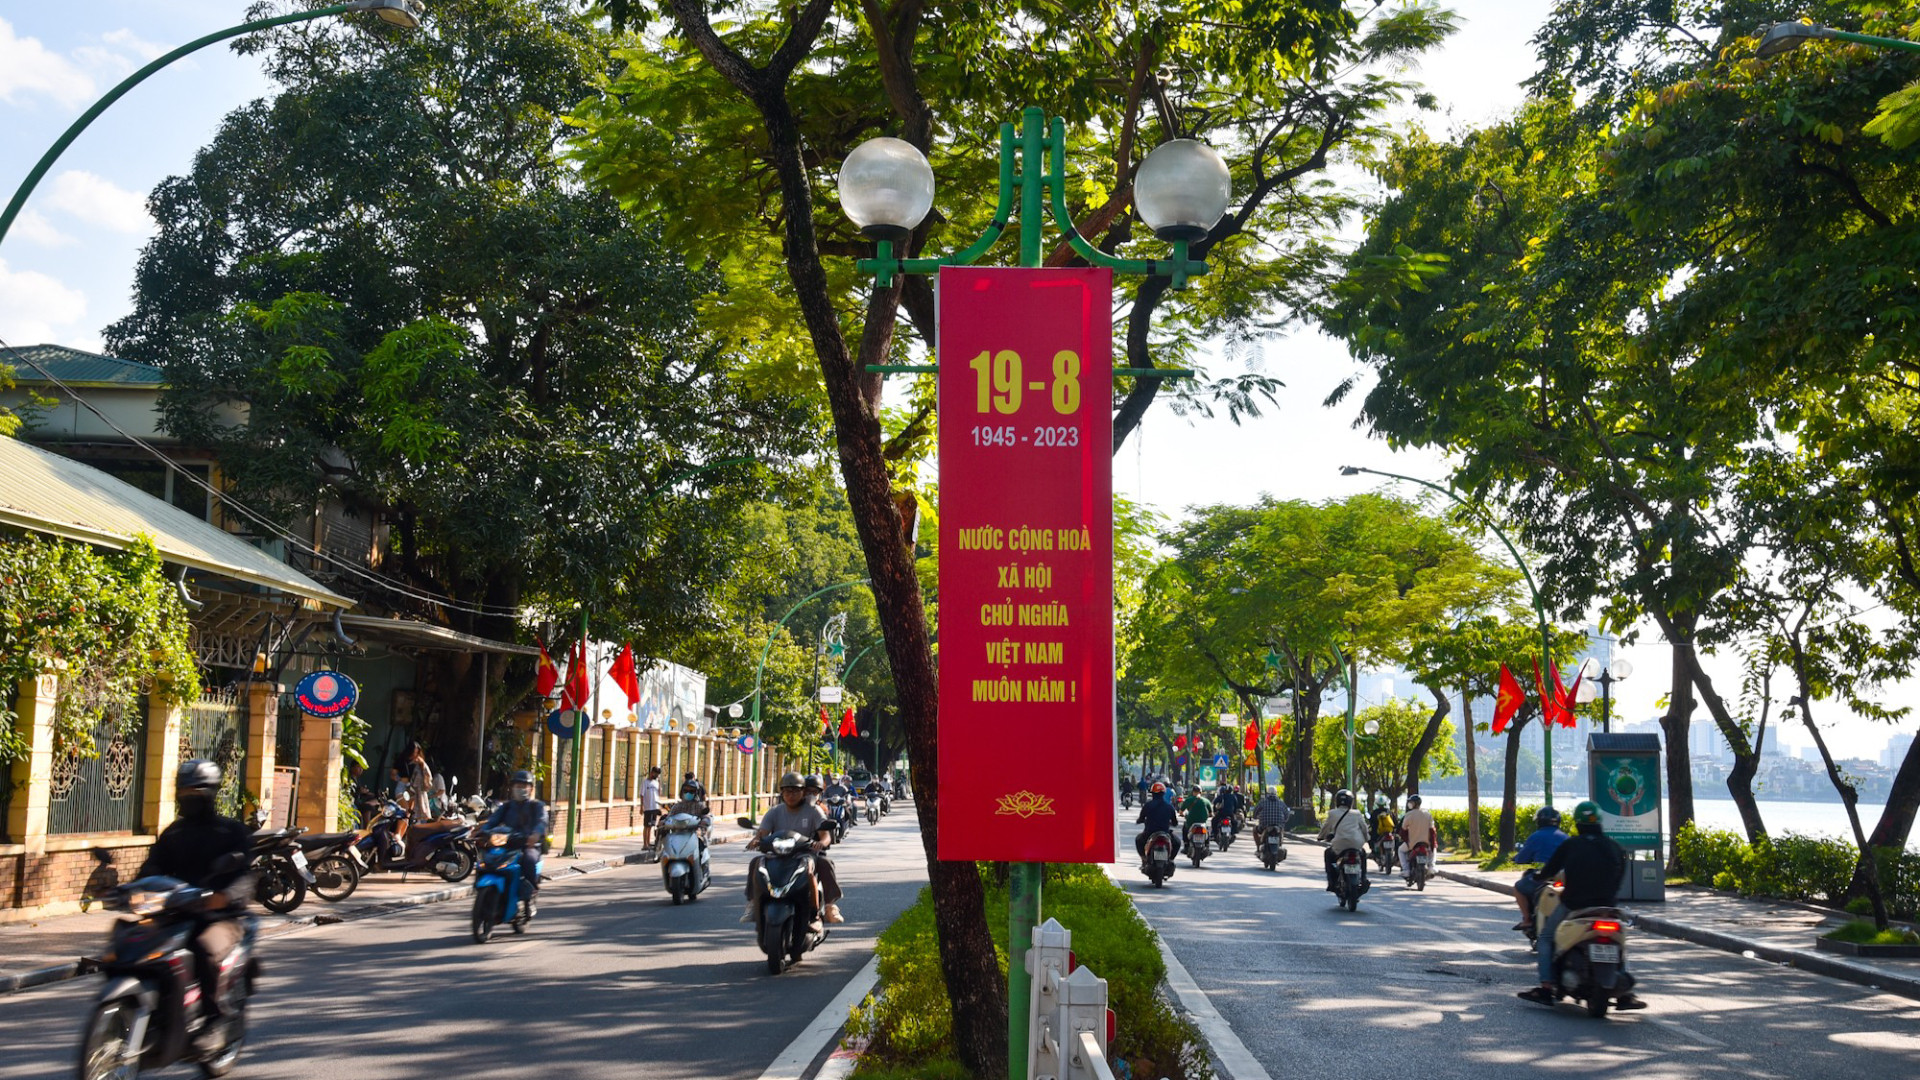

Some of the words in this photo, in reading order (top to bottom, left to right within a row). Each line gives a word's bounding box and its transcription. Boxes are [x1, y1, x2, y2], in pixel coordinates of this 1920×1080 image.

[971, 426, 1016, 447] 1945
[1033, 426, 1079, 447] 2023
[959, 524, 1004, 551] NƯỚC
[1008, 524, 1053, 556] CỘNG
[1058, 524, 1092, 551] HOÀ
[997, 562, 1020, 588] XÃ
[1024, 561, 1052, 593] HỘI
[980, 596, 1013, 626] CHỦ
[1018, 600, 1069, 626] NGHĨA
[986, 637, 1021, 669] VIỆT
[1024, 642, 1064, 664] NAM
[972, 675, 1022, 702] MUÔN
[1026, 675, 1065, 702] NĂM
